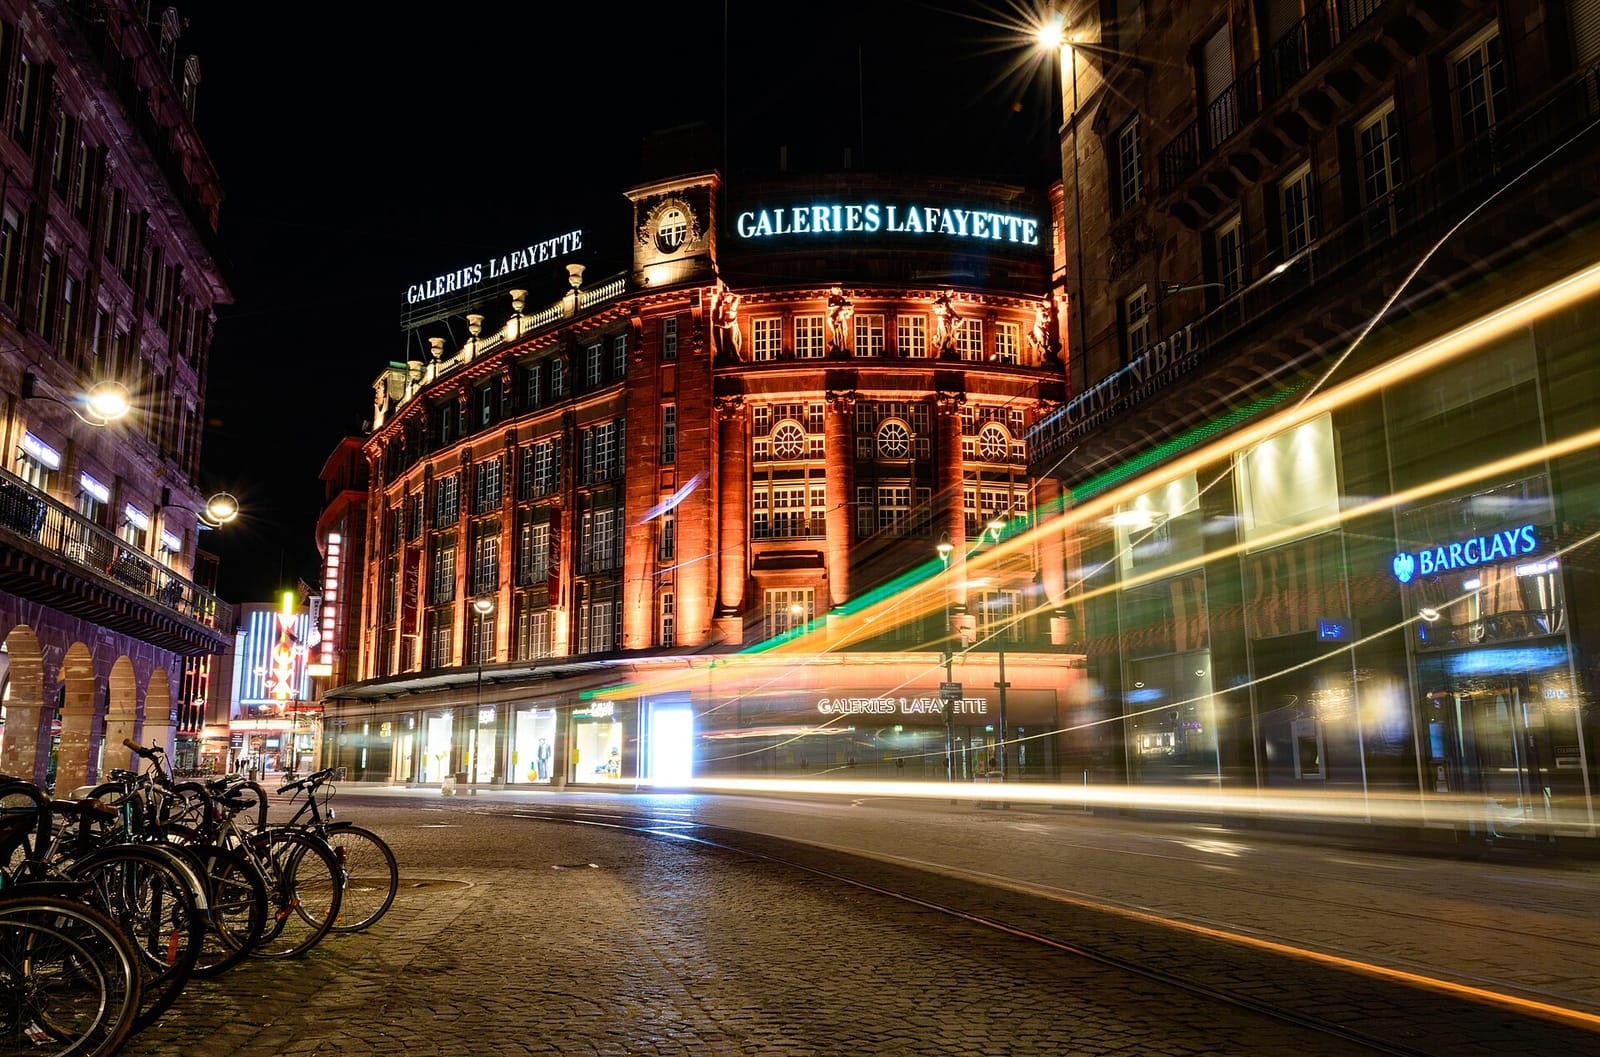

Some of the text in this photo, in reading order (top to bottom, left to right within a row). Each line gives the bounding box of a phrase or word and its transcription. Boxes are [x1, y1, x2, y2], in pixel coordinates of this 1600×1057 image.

[736, 204, 1040, 245] GALERIES LAFAYETTE
[406, 229, 583, 305] GALERIES LAFAYETTE
[1028, 322, 1201, 449] DETECTIVE NIBEL
[1419, 523, 1538, 576] BARCLAYS
[817, 697, 896, 714] GALERIES
